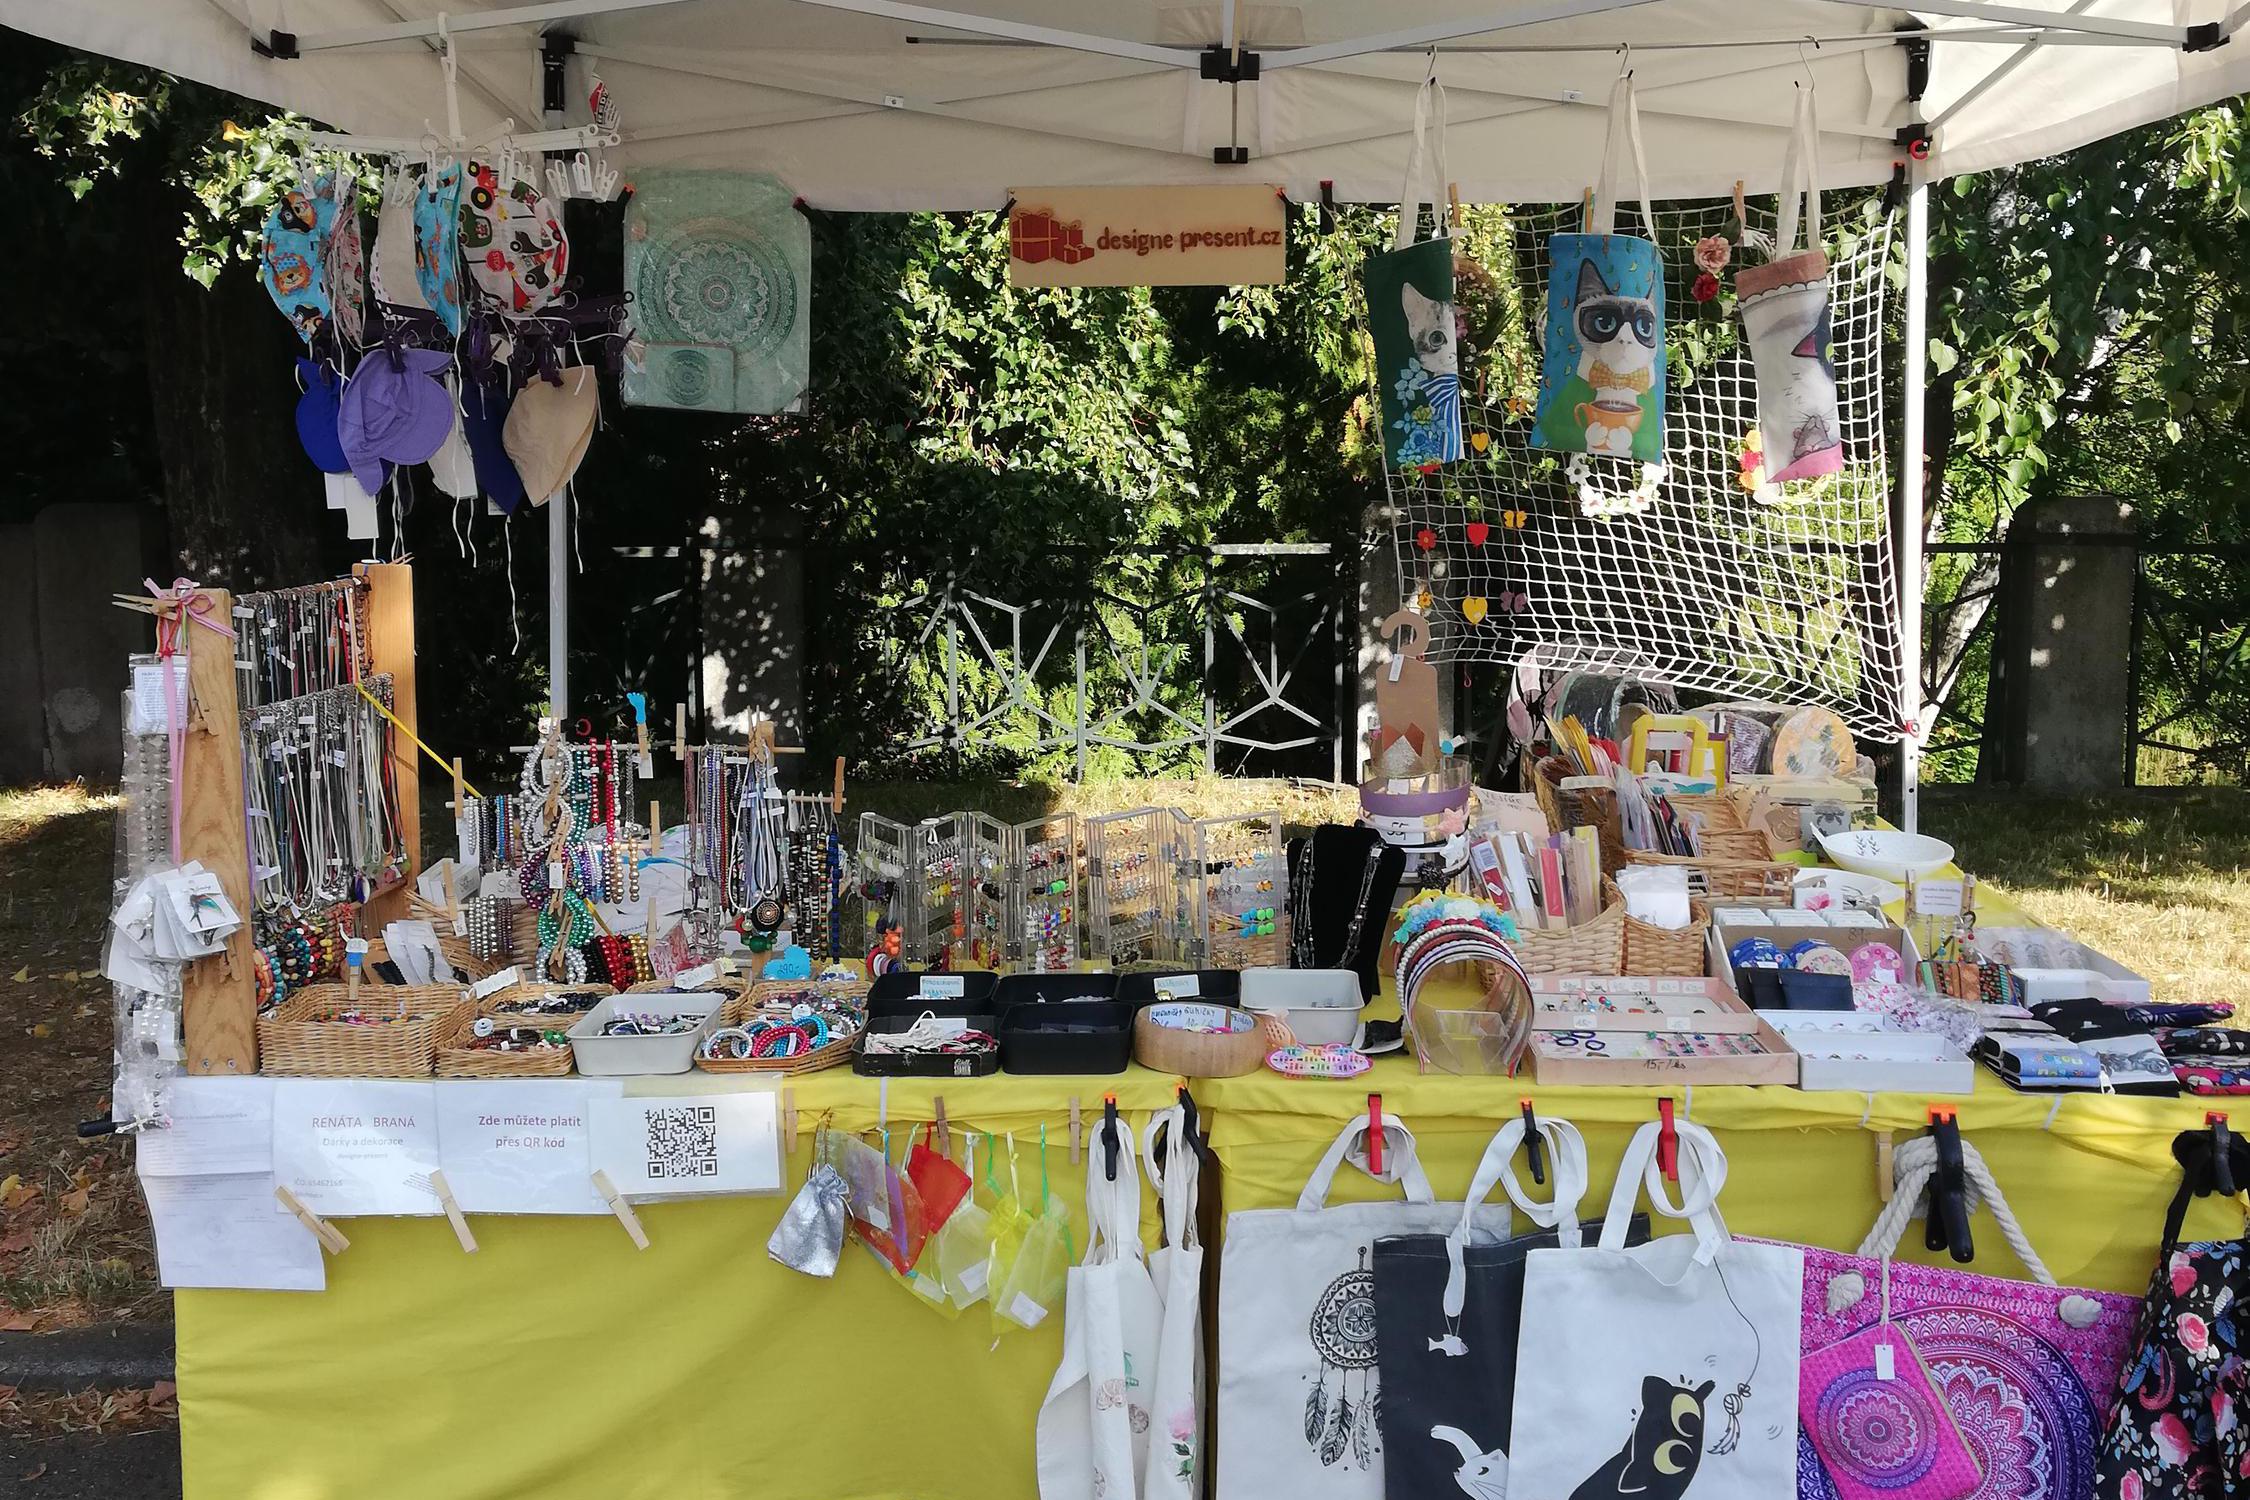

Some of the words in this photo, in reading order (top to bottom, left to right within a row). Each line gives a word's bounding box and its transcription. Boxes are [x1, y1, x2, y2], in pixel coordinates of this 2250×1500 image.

[1096, 225, 1174, 256] designe
[1180, 226, 1282, 253] present.cz
[311, 1115, 363, 1129] RENÁTA
[373, 1115, 416, 1129] BRANÁ
[478, 1115, 501, 1126] Zde
[503, 1115, 547, 1127] můžete
[550, 1115, 582, 1129] platit
[322, 1137, 350, 1148] Dárky
[352, 1139, 359, 1147] a
[360, 1137, 404, 1147] dekorace
[495, 1136, 520, 1149] přes
[523, 1137, 541, 1149] QR
[543, 1137, 566, 1148] kód
